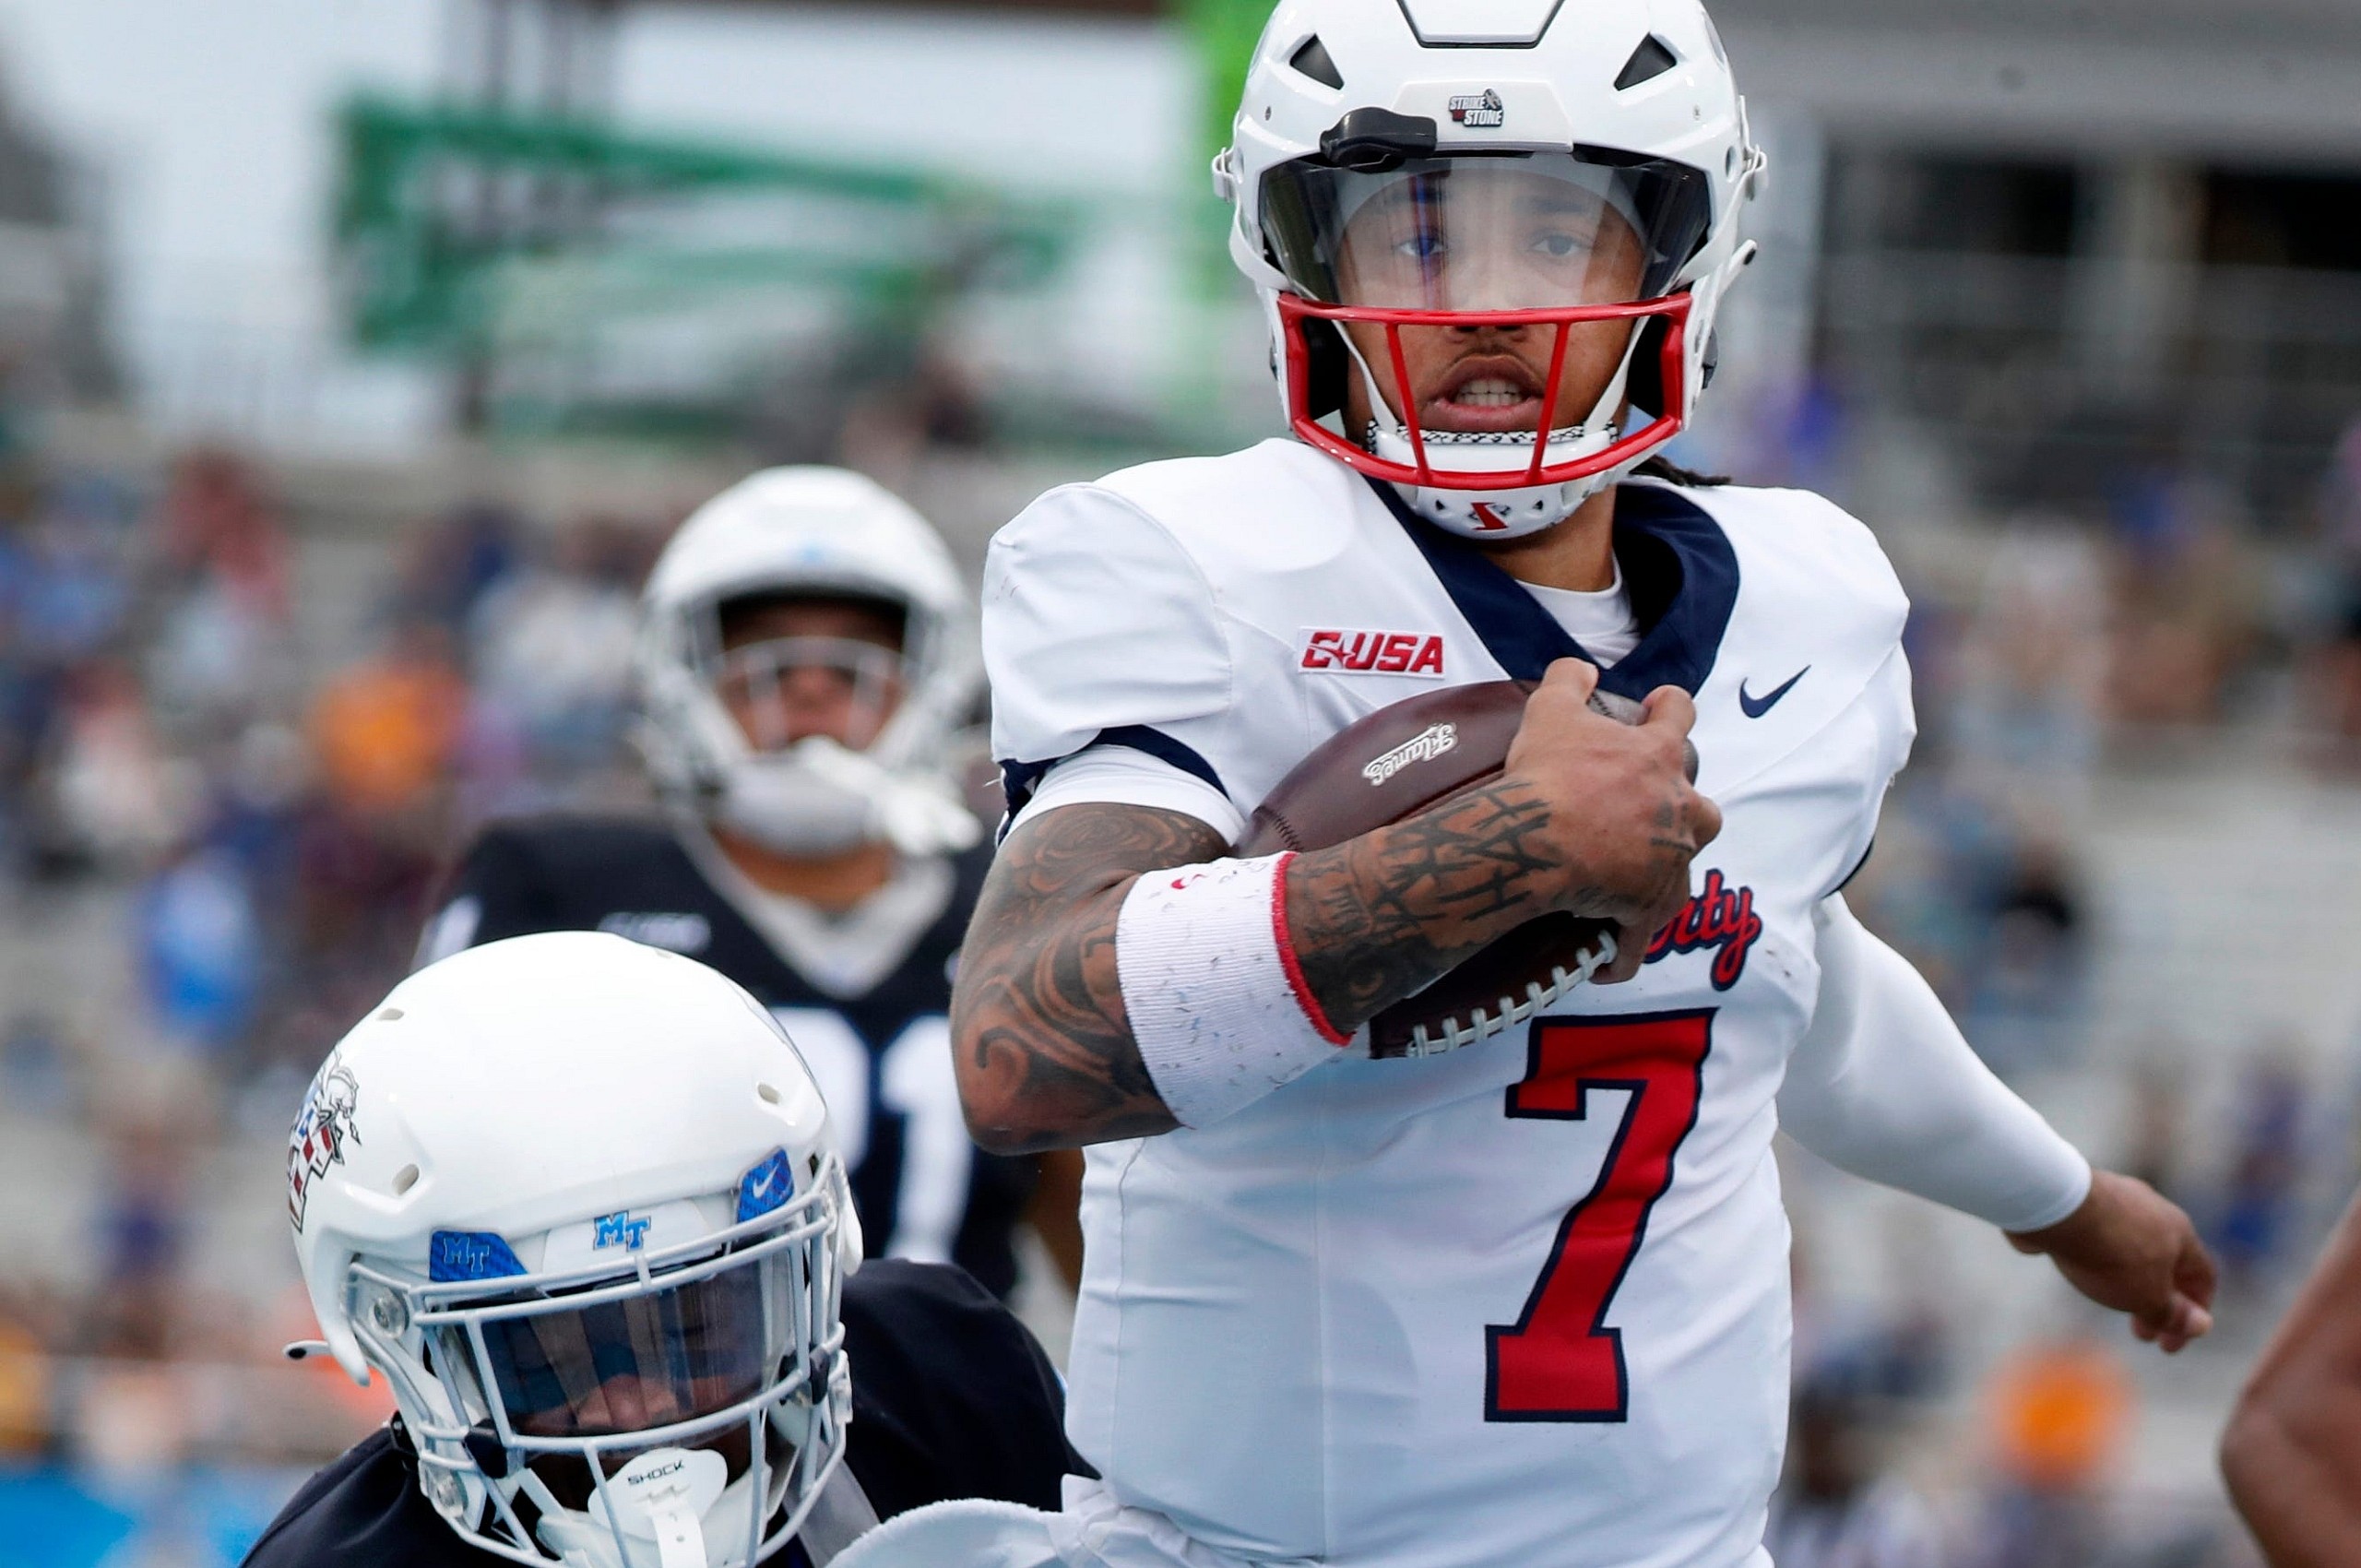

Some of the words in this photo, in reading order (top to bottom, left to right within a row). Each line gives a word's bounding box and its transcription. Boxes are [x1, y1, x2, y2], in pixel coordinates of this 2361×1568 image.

[1463, 110, 1502, 125] STONE
[1362, 722, 1457, 786] Flames
[593, 1209, 651, 1252] MT
[1484, 1006, 1720, 1422] 7
[443, 1236, 490, 1273] MT
[627, 1458, 684, 1485] SHOCK
